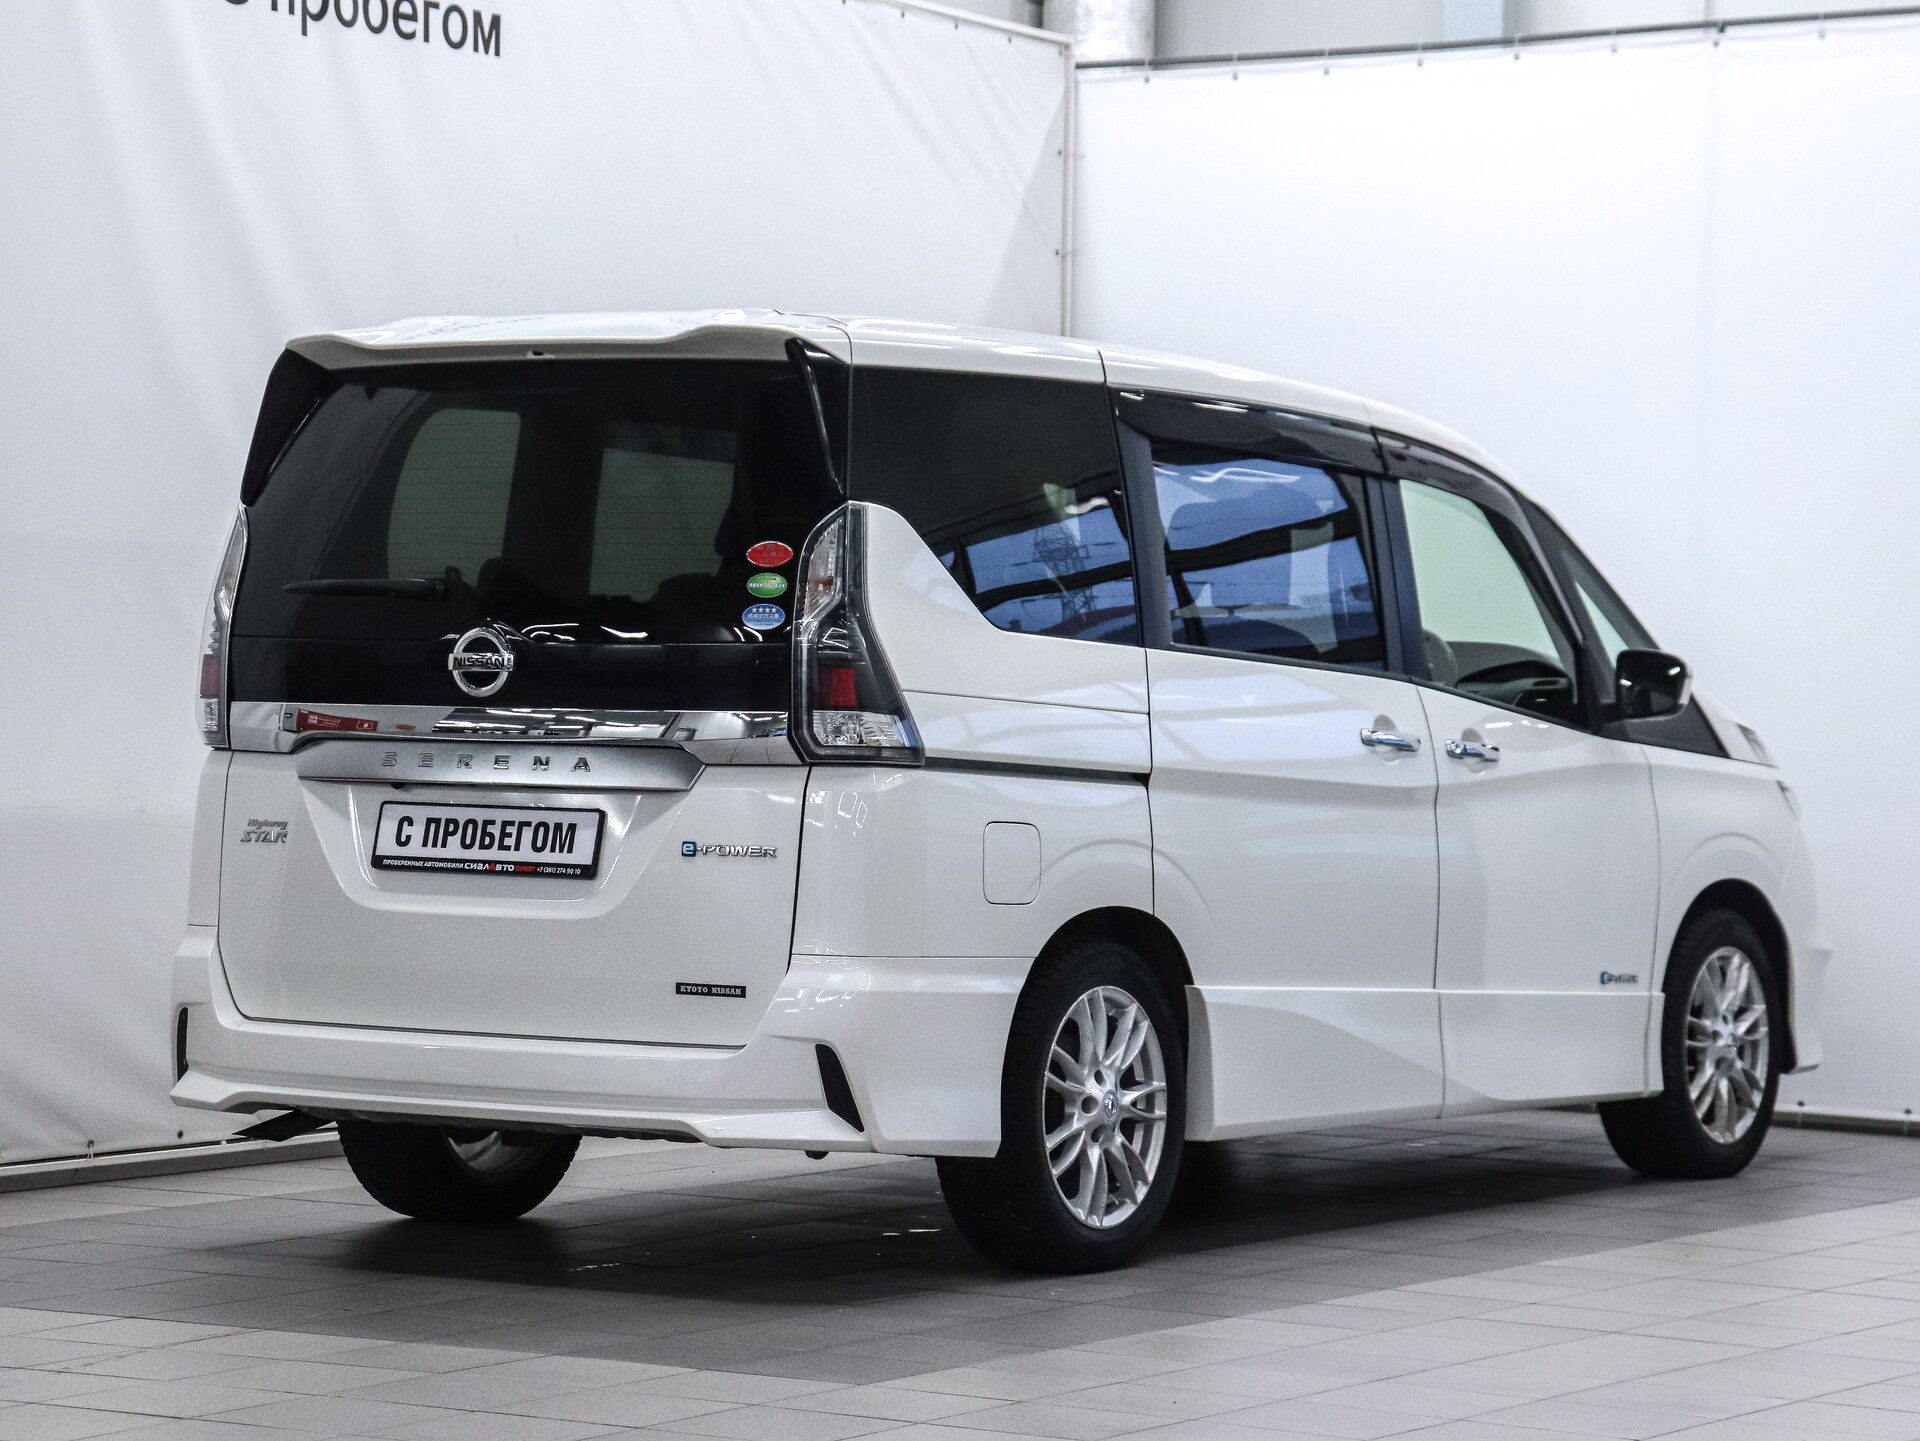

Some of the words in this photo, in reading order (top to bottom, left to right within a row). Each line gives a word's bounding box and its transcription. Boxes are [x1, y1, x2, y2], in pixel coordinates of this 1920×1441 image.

[453, 656, 505, 668] NISSAN
[381, 751, 591, 773] SERENA
[240, 830, 288, 843] STAR
[395, 815, 414, 848] С
[421, 817, 578, 854] ПРОБЕГОМ
[681, 841, 777, 858] e-POWER
[423, 861, 464, 869] АВТОМОБИЛИ
[680, 985, 708, 993] KYOTO
[711, 987, 742, 995] NISSAN
